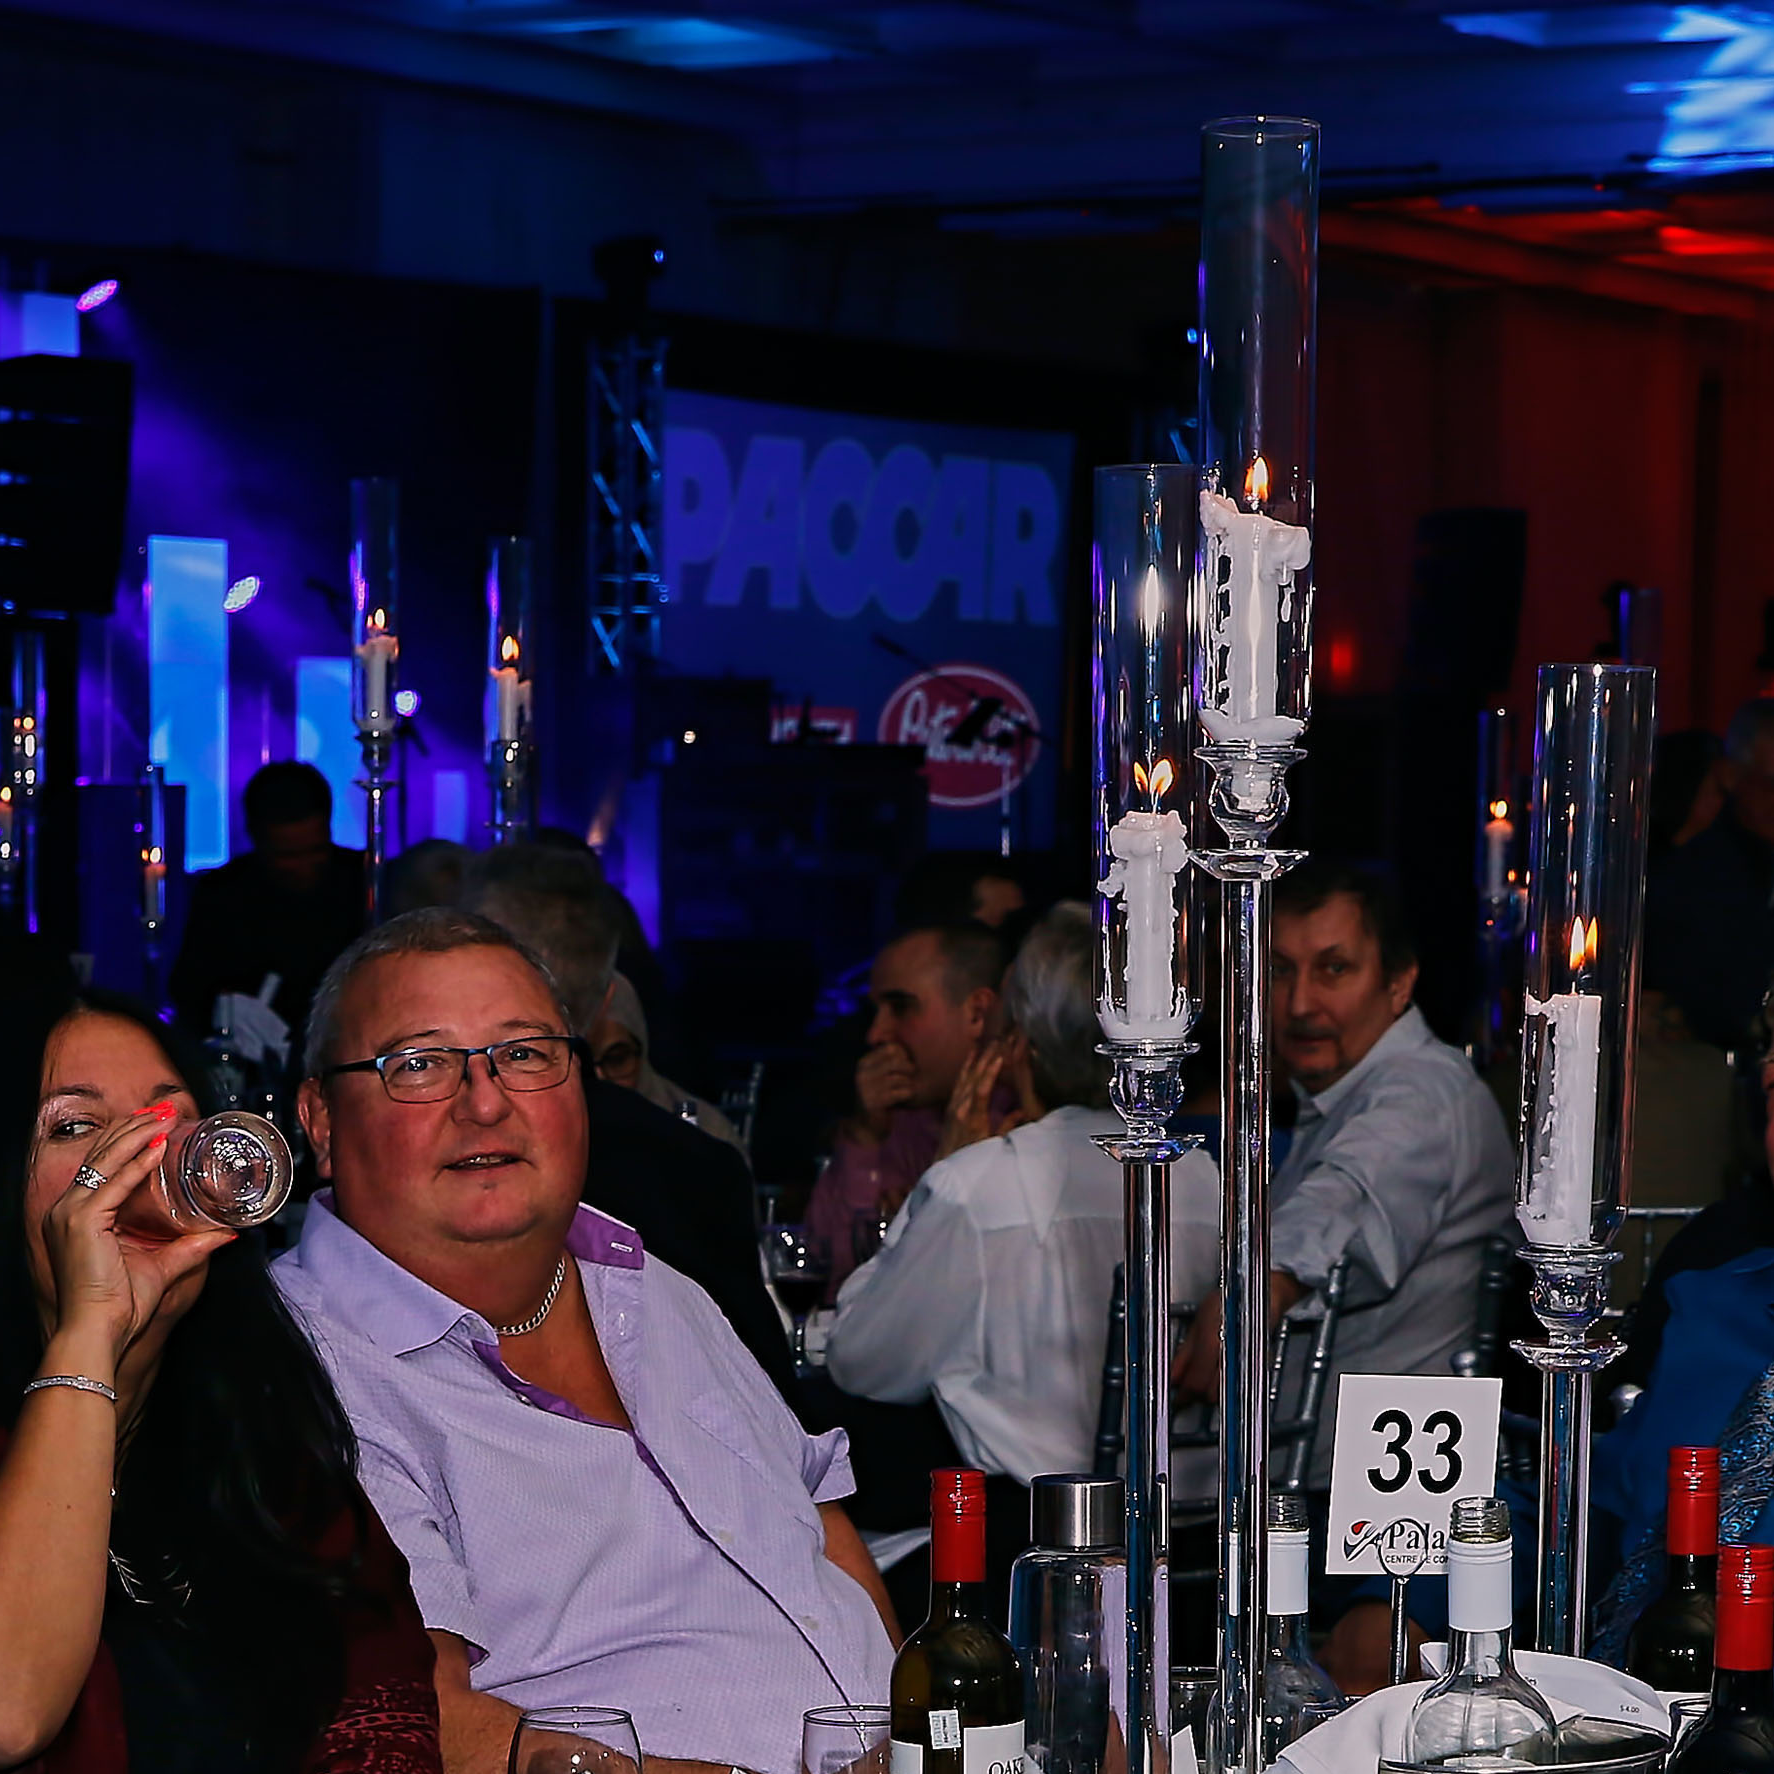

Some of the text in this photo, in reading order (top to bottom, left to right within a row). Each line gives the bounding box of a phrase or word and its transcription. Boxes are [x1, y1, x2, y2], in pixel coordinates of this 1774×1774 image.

[662, 426, 1060, 627] PACCAR
[1367, 1409, 1463, 1494] 33
[1385, 1555, 1418, 1563] CENTRE
[1387, 1522, 1446, 1550] Pala
